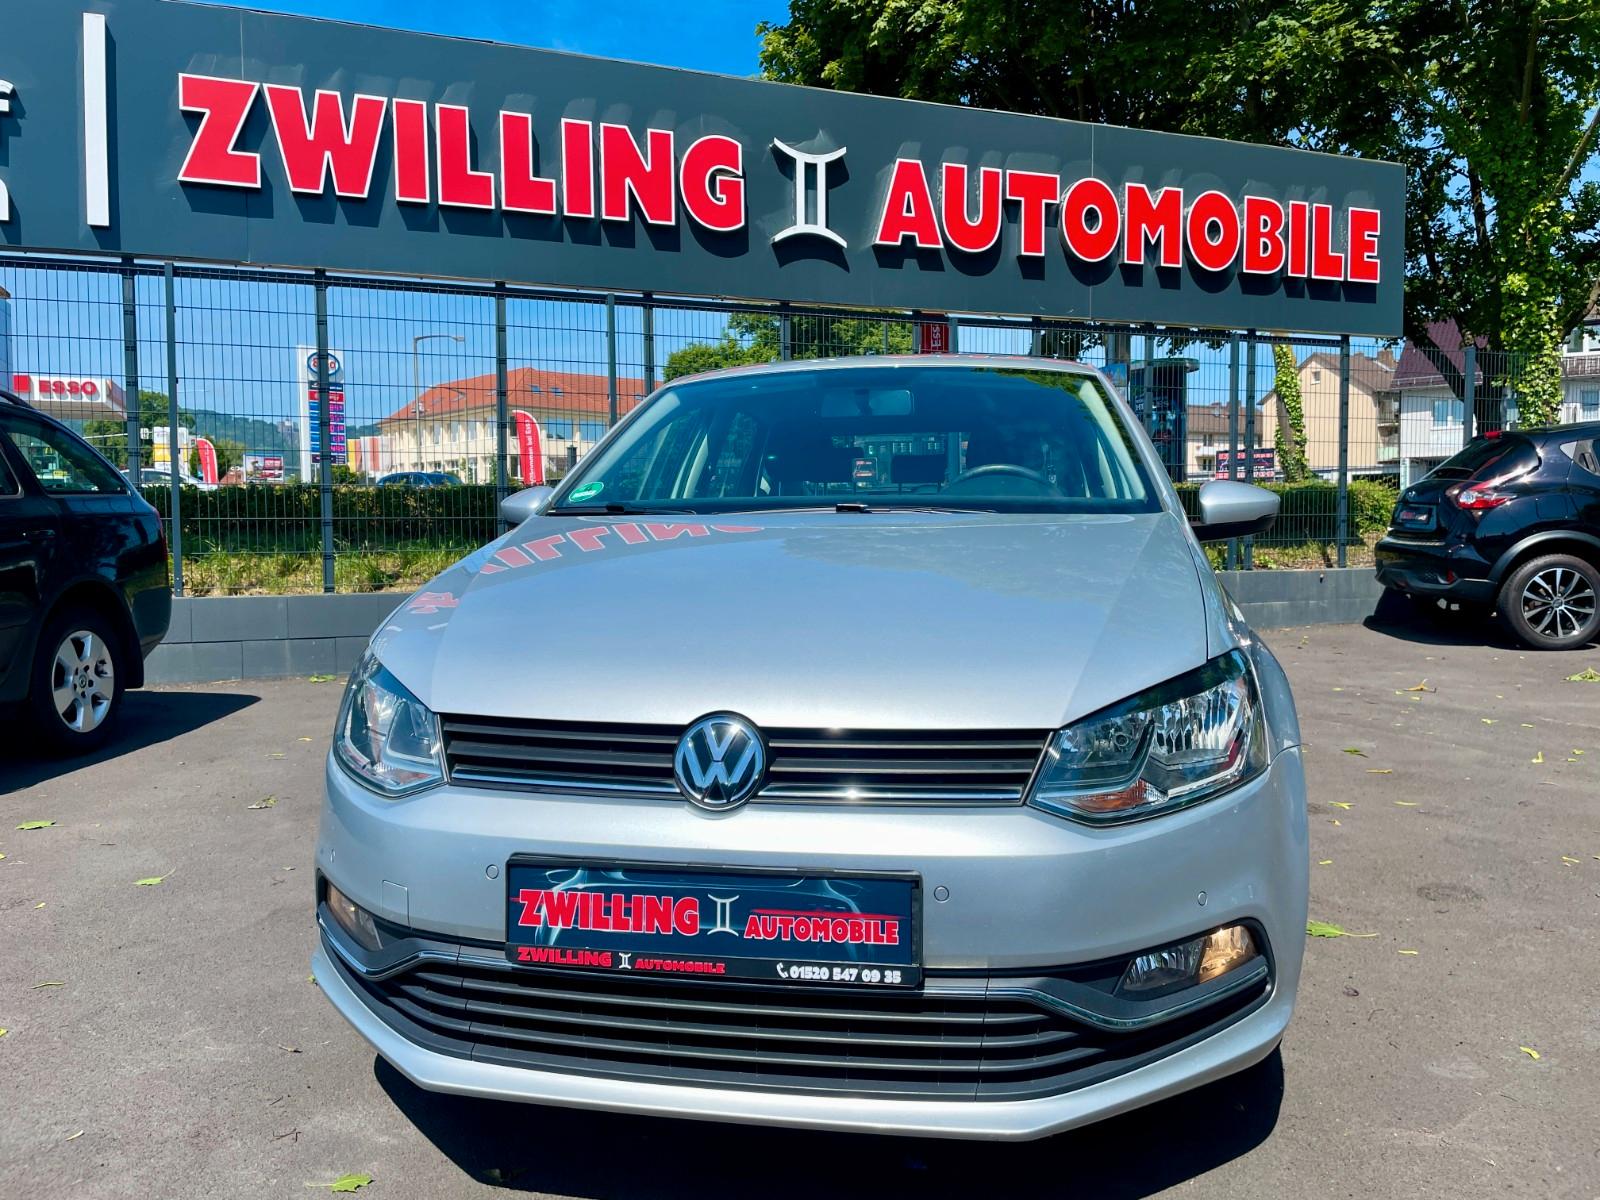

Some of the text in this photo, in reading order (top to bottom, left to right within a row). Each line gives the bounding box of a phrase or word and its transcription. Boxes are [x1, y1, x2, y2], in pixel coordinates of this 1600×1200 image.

[177, 72, 1382, 285] ZWILLING AUTOMOBILE
[675, 715, 764, 804] VW
[518, 889, 900, 946] ZWILLING AUTOMOBILE
[517, 946, 725, 974] ZWILLING AUTOMOBILE
[789, 964, 902, 984] 01520 547 09 35
